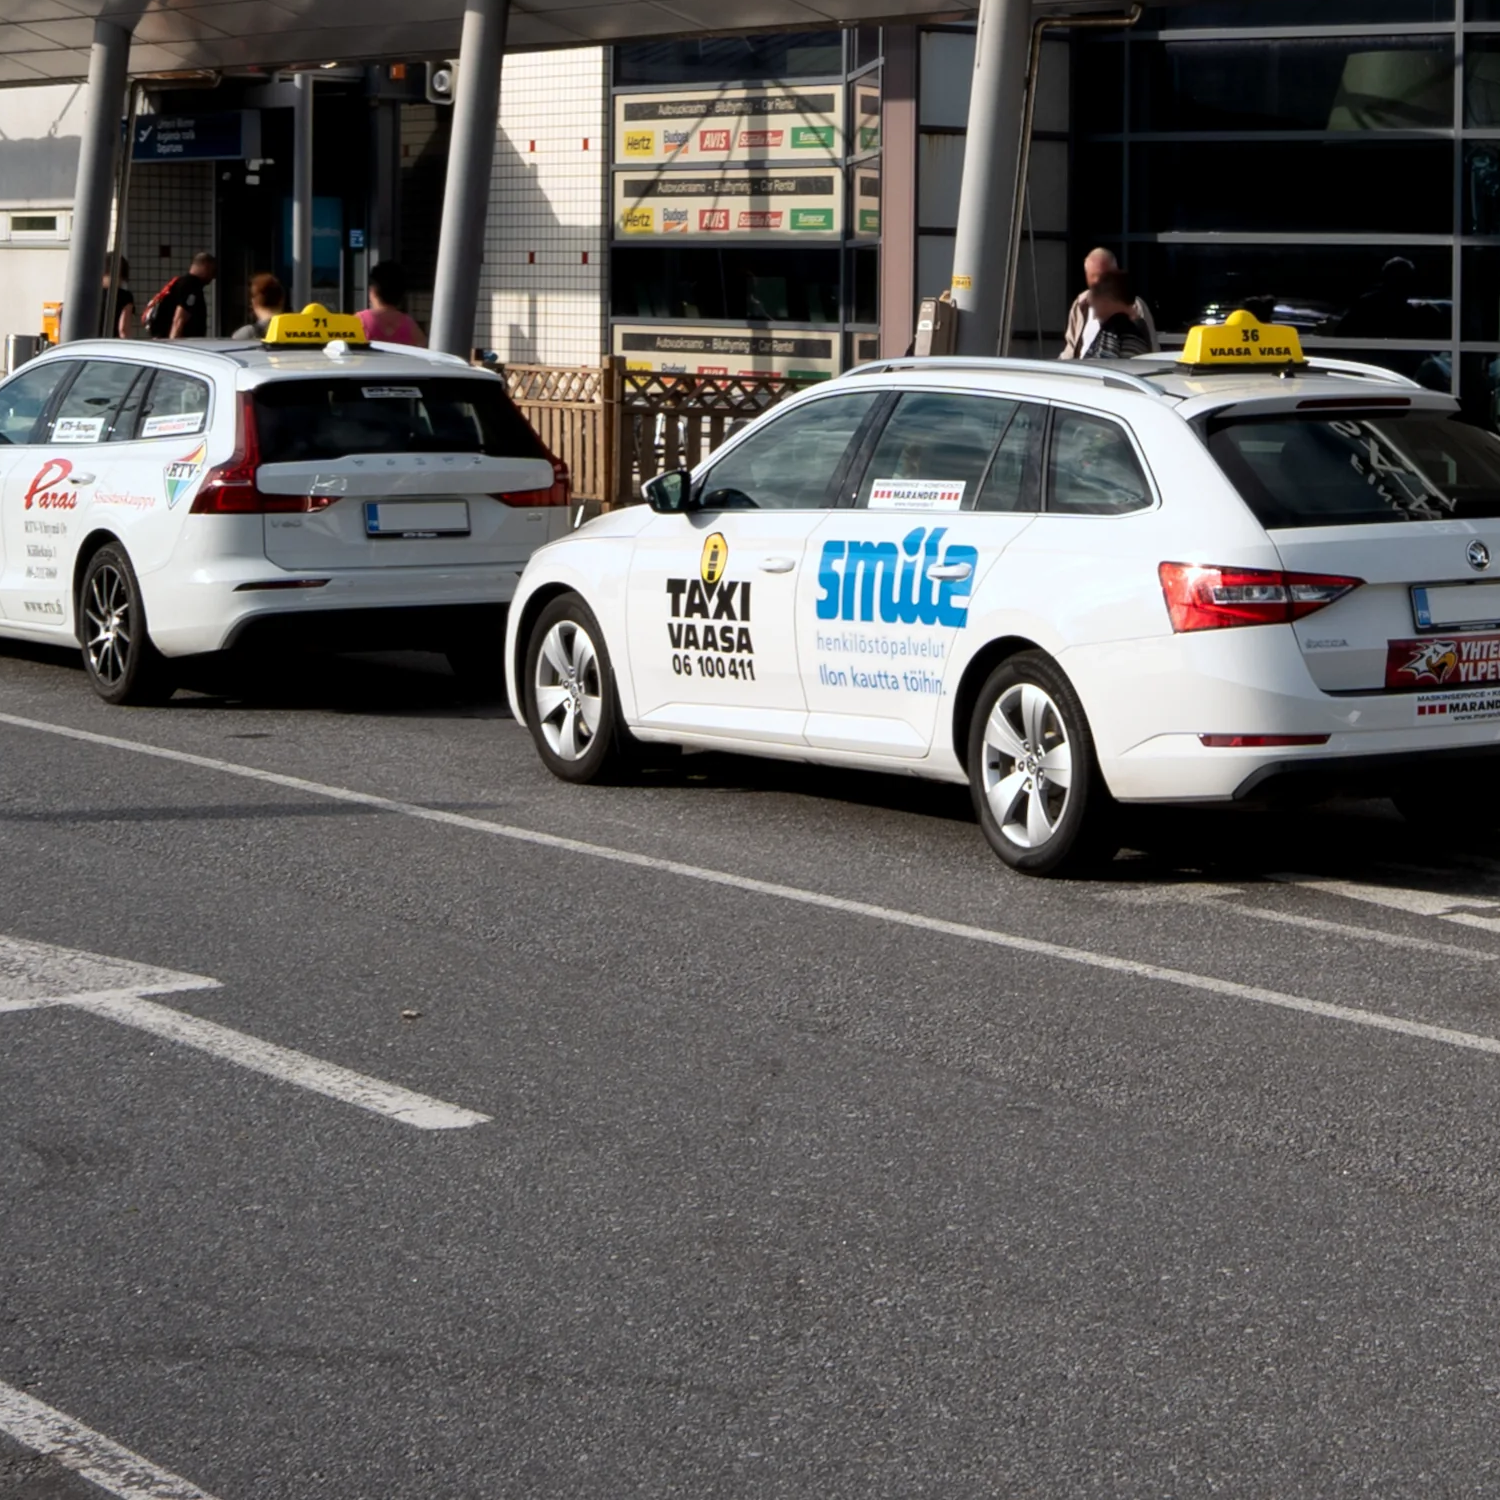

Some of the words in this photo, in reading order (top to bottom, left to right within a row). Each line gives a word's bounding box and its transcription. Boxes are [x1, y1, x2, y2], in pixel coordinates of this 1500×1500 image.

[625, 136, 651, 150] Hertz
[663, 129, 689, 146] Budget
[702, 131, 728, 149] AVIS
[625, 211, 651, 227] Hertz
[663, 208, 689, 223] Budget
[702, 210, 726, 228] AVIS
[312, 318, 328, 328] 71
[1241, 329, 1259, 342] 36
[1209, 347, 1252, 356] VAASA
[1258, 347, 1292, 356] VASA
[167, 463, 196, 478] RTV
[24, 458, 78, 510] Paras
[893, 490, 939, 500] MARANDER
[816, 526, 979, 628] smile
[666, 578, 751, 622] TAXI
[667, 623, 754, 654] VAASA
[816, 629, 946, 660] henkilöstöpalvelut
[672, 654, 693, 676] 06
[851, 665, 899, 691] kautta
[902, 669, 947, 696] töihin.
[1417, 690, 1486, 702] MASKINSERVICE
